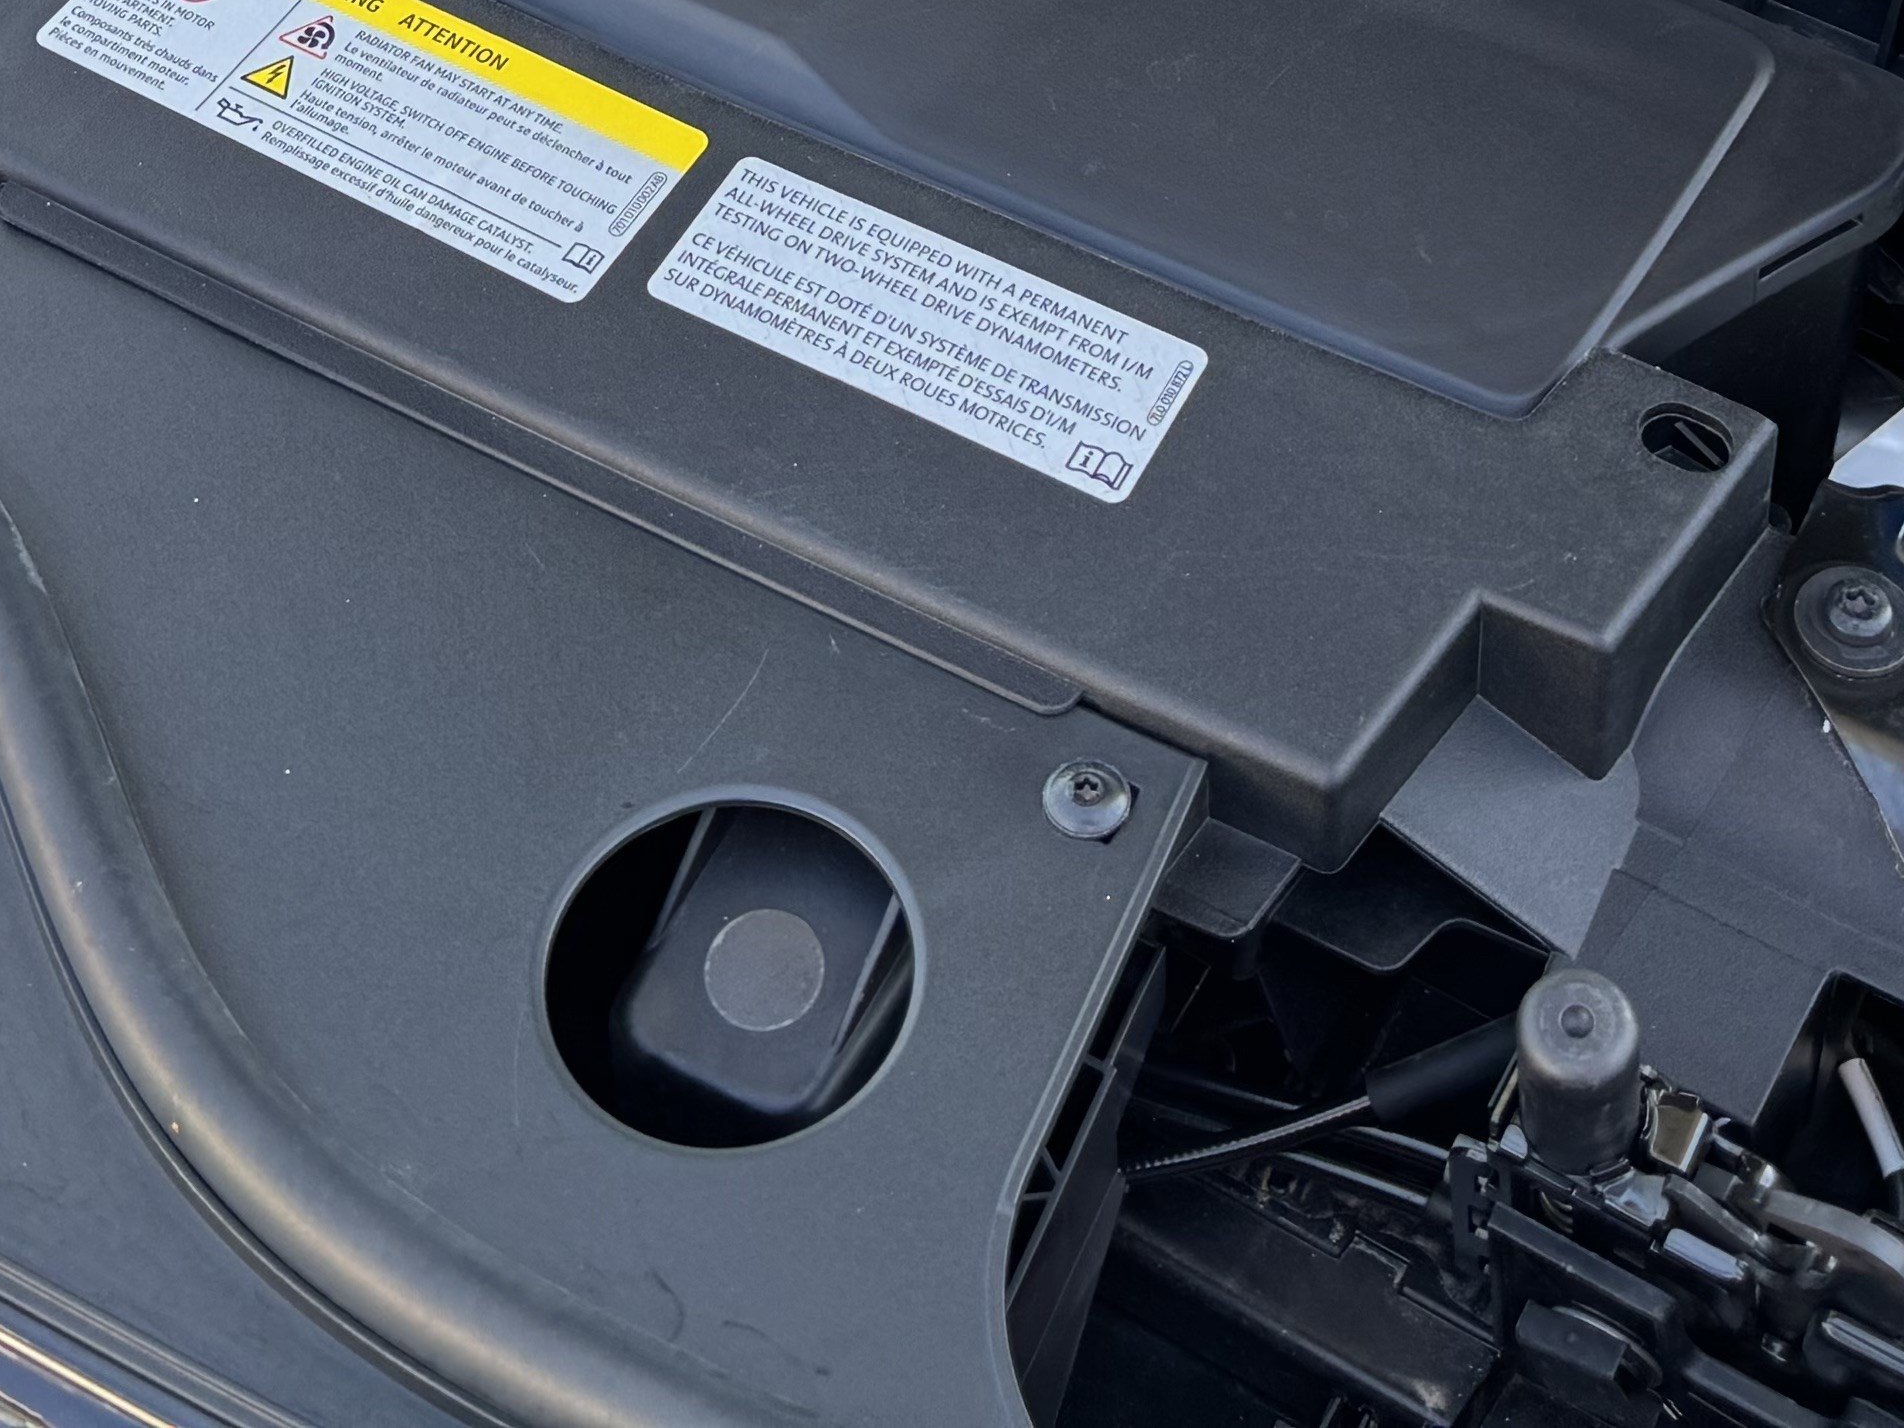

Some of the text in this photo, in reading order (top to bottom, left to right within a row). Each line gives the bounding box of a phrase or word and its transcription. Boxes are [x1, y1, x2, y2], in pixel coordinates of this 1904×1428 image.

[47, 26, 166, 91] Pièces en mouvement.
[58, 15, 190, 86] le compartiment moteur.
[70, 5, 219, 83] Composants très chauds dans
[126, 13, 163, 37] PARTS.
[159, 0, 176, 12] IN
[173, 5, 216, 31] MOTOR
[333, 53, 383, 83] moment.
[354, 29, 564, 135] RADIATOR FAN MAY START AT ANY TIME.
[397, 13, 510, 71] ATTENTION
[289, 99, 349, 135] l'allumage.
[295, 88, 585, 233] Haute tension, arrêter le moteur avant de toucher à
[310, 77, 406, 130] IGNITION SYSTEM.
[319, 67, 618, 215] HIGH VOLTAGE, SWITCH OFF ENGINE BEFORE TOUCHING
[343, 41, 633, 185] Le ventilateur de radiateur peut se déclencher à tout
[260, 130, 579, 294] Remplissage excessif d'huile dangereux pour le catalyseur.
[271, 119, 534, 255] OVERFILLED ENGINE OIL CAN DAMAGE CATALYST.
[714, 202, 1122, 393] TESTING ON TWO-WHEEL DRIVE DYNAMOMETERS.
[723, 186, 1154, 380] ALL-WHEEL DRIVE SYSTEM AND IS EXEMPT FROM I/M
[740, 167, 1130, 345] THIS VEHICLE IS EQUIPPED WITH A PERMANENT
[663, 267, 1047, 449] SUR DYNAMOMÈTRES À DEUX ROUES MOTRICES.
[676, 249, 1078, 436] INTÉGRALE PERMANENT ET EXEMPTÉ D'ESSAIS D'I/M
[691, 232, 1148, 442] CE VÉHICULE EST DOTÉ D'UN SYSTÈME DE TRANSMISSION
